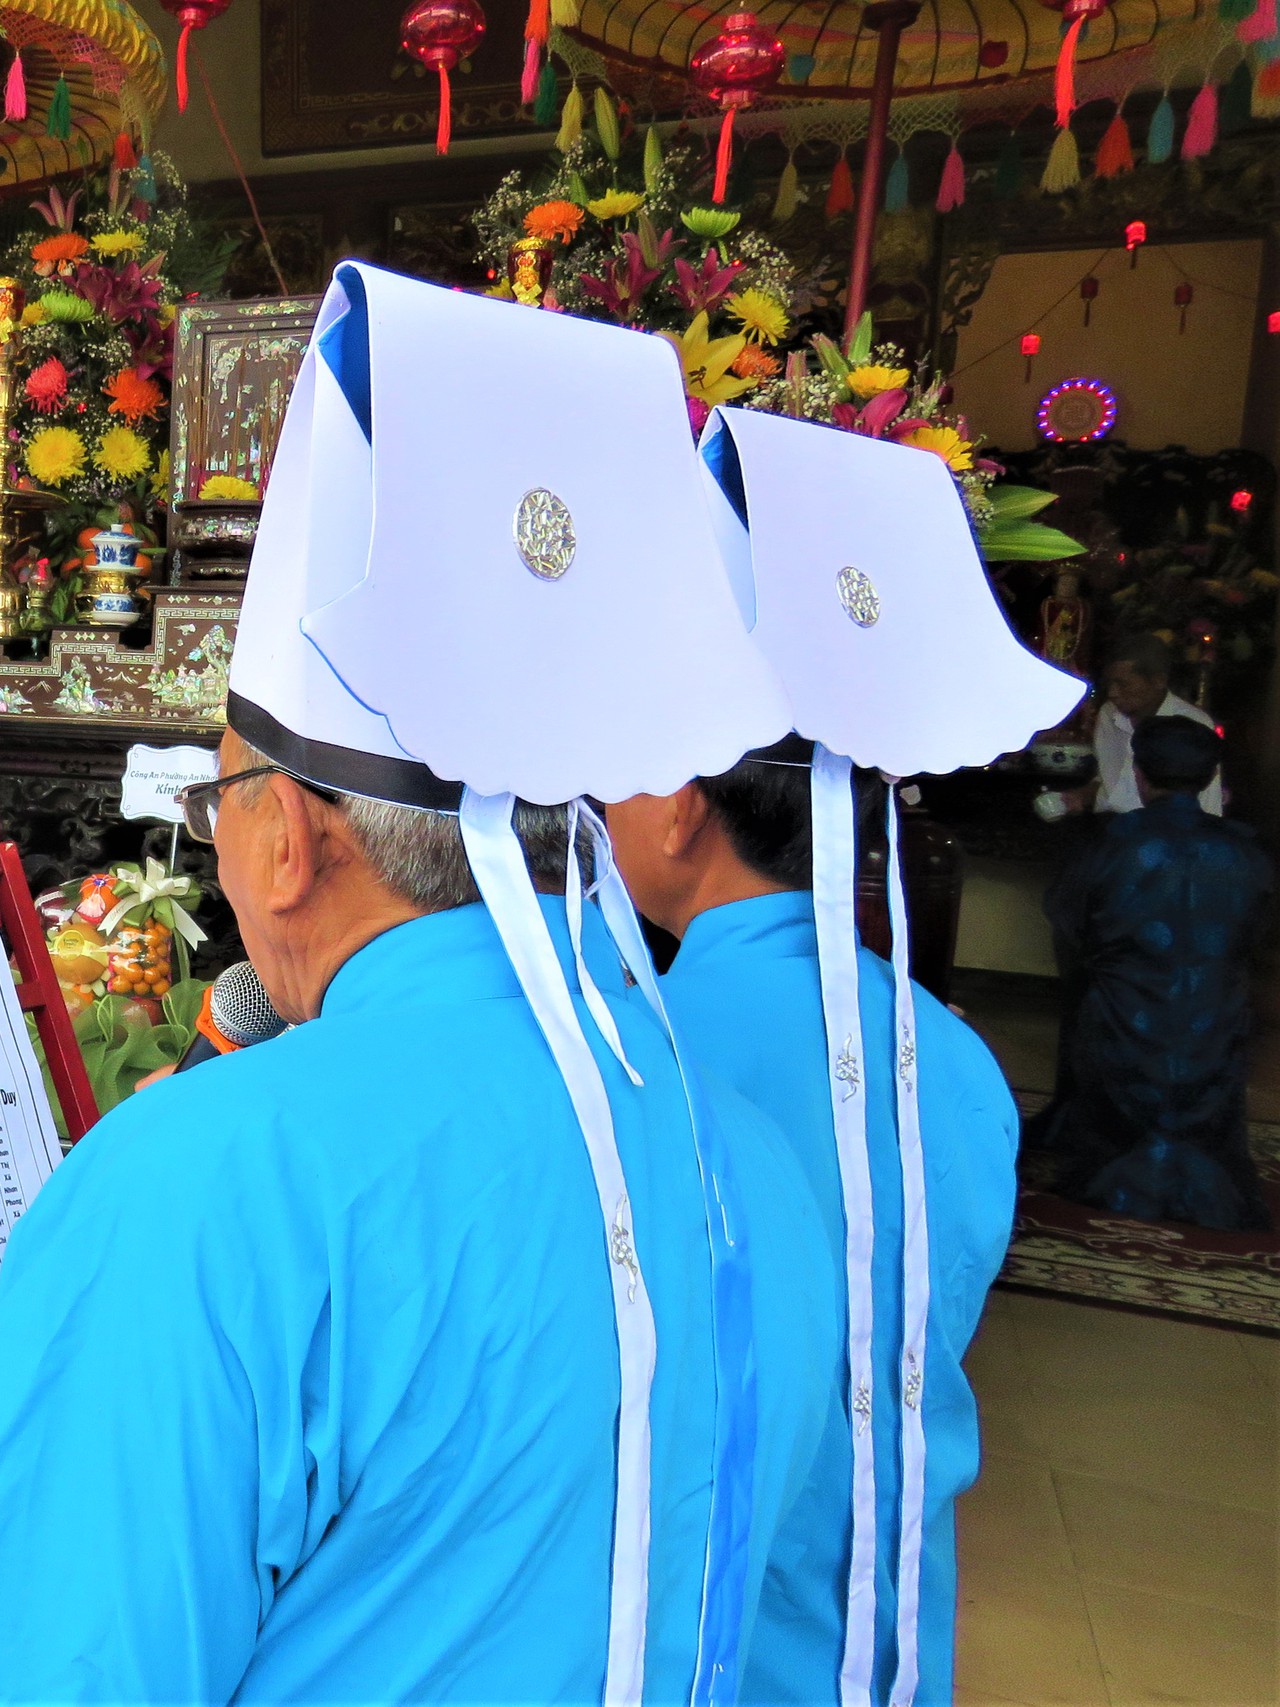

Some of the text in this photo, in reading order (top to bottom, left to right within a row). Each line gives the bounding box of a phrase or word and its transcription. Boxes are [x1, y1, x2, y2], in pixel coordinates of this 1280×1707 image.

[130, 770, 148, 780] Công
[148, 771, 159, 779] An
[160, 772, 188, 782] Phường
[188, 773, 199, 781] An
[0, 1088, 17, 1107] Duy
